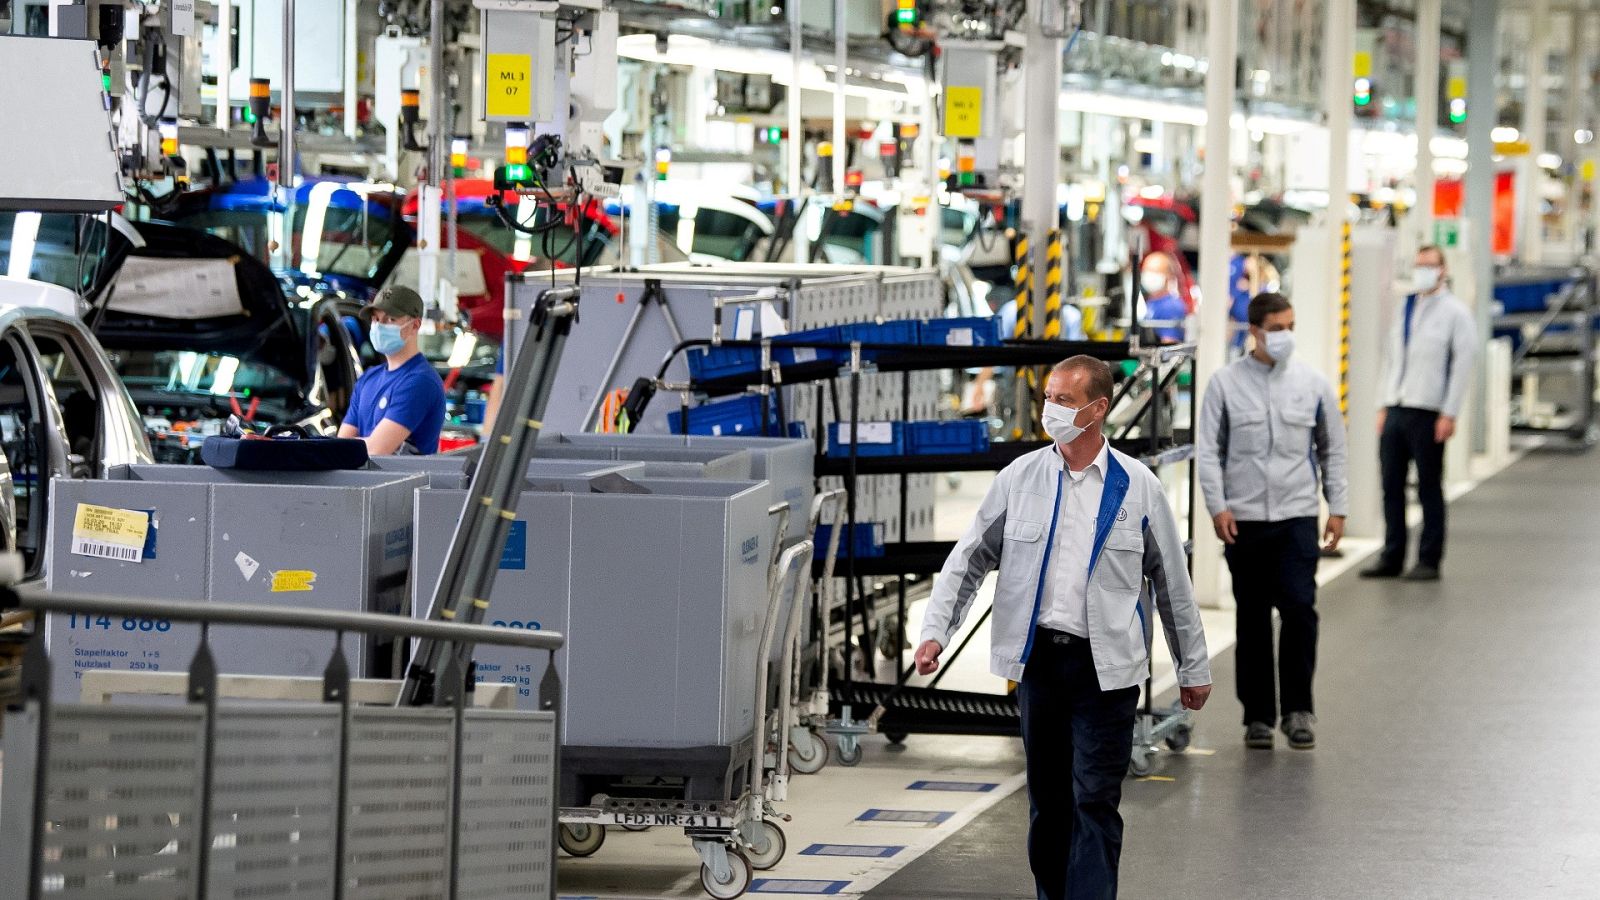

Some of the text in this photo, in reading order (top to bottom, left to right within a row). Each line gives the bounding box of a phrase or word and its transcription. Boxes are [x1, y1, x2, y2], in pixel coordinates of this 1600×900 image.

[500, 71, 515, 80] ML
[505, 86, 518, 96] 07
[74, 648, 129, 658] Stapelfaktor
[74, 660, 159, 671] Nutzlast 250 kg
[476, 663, 531, 672] faktor 1+5
[501, 675, 530, 685] 250 kg
[519, 687, 530, 697] kg
[614, 812, 650, 825] LFD:
